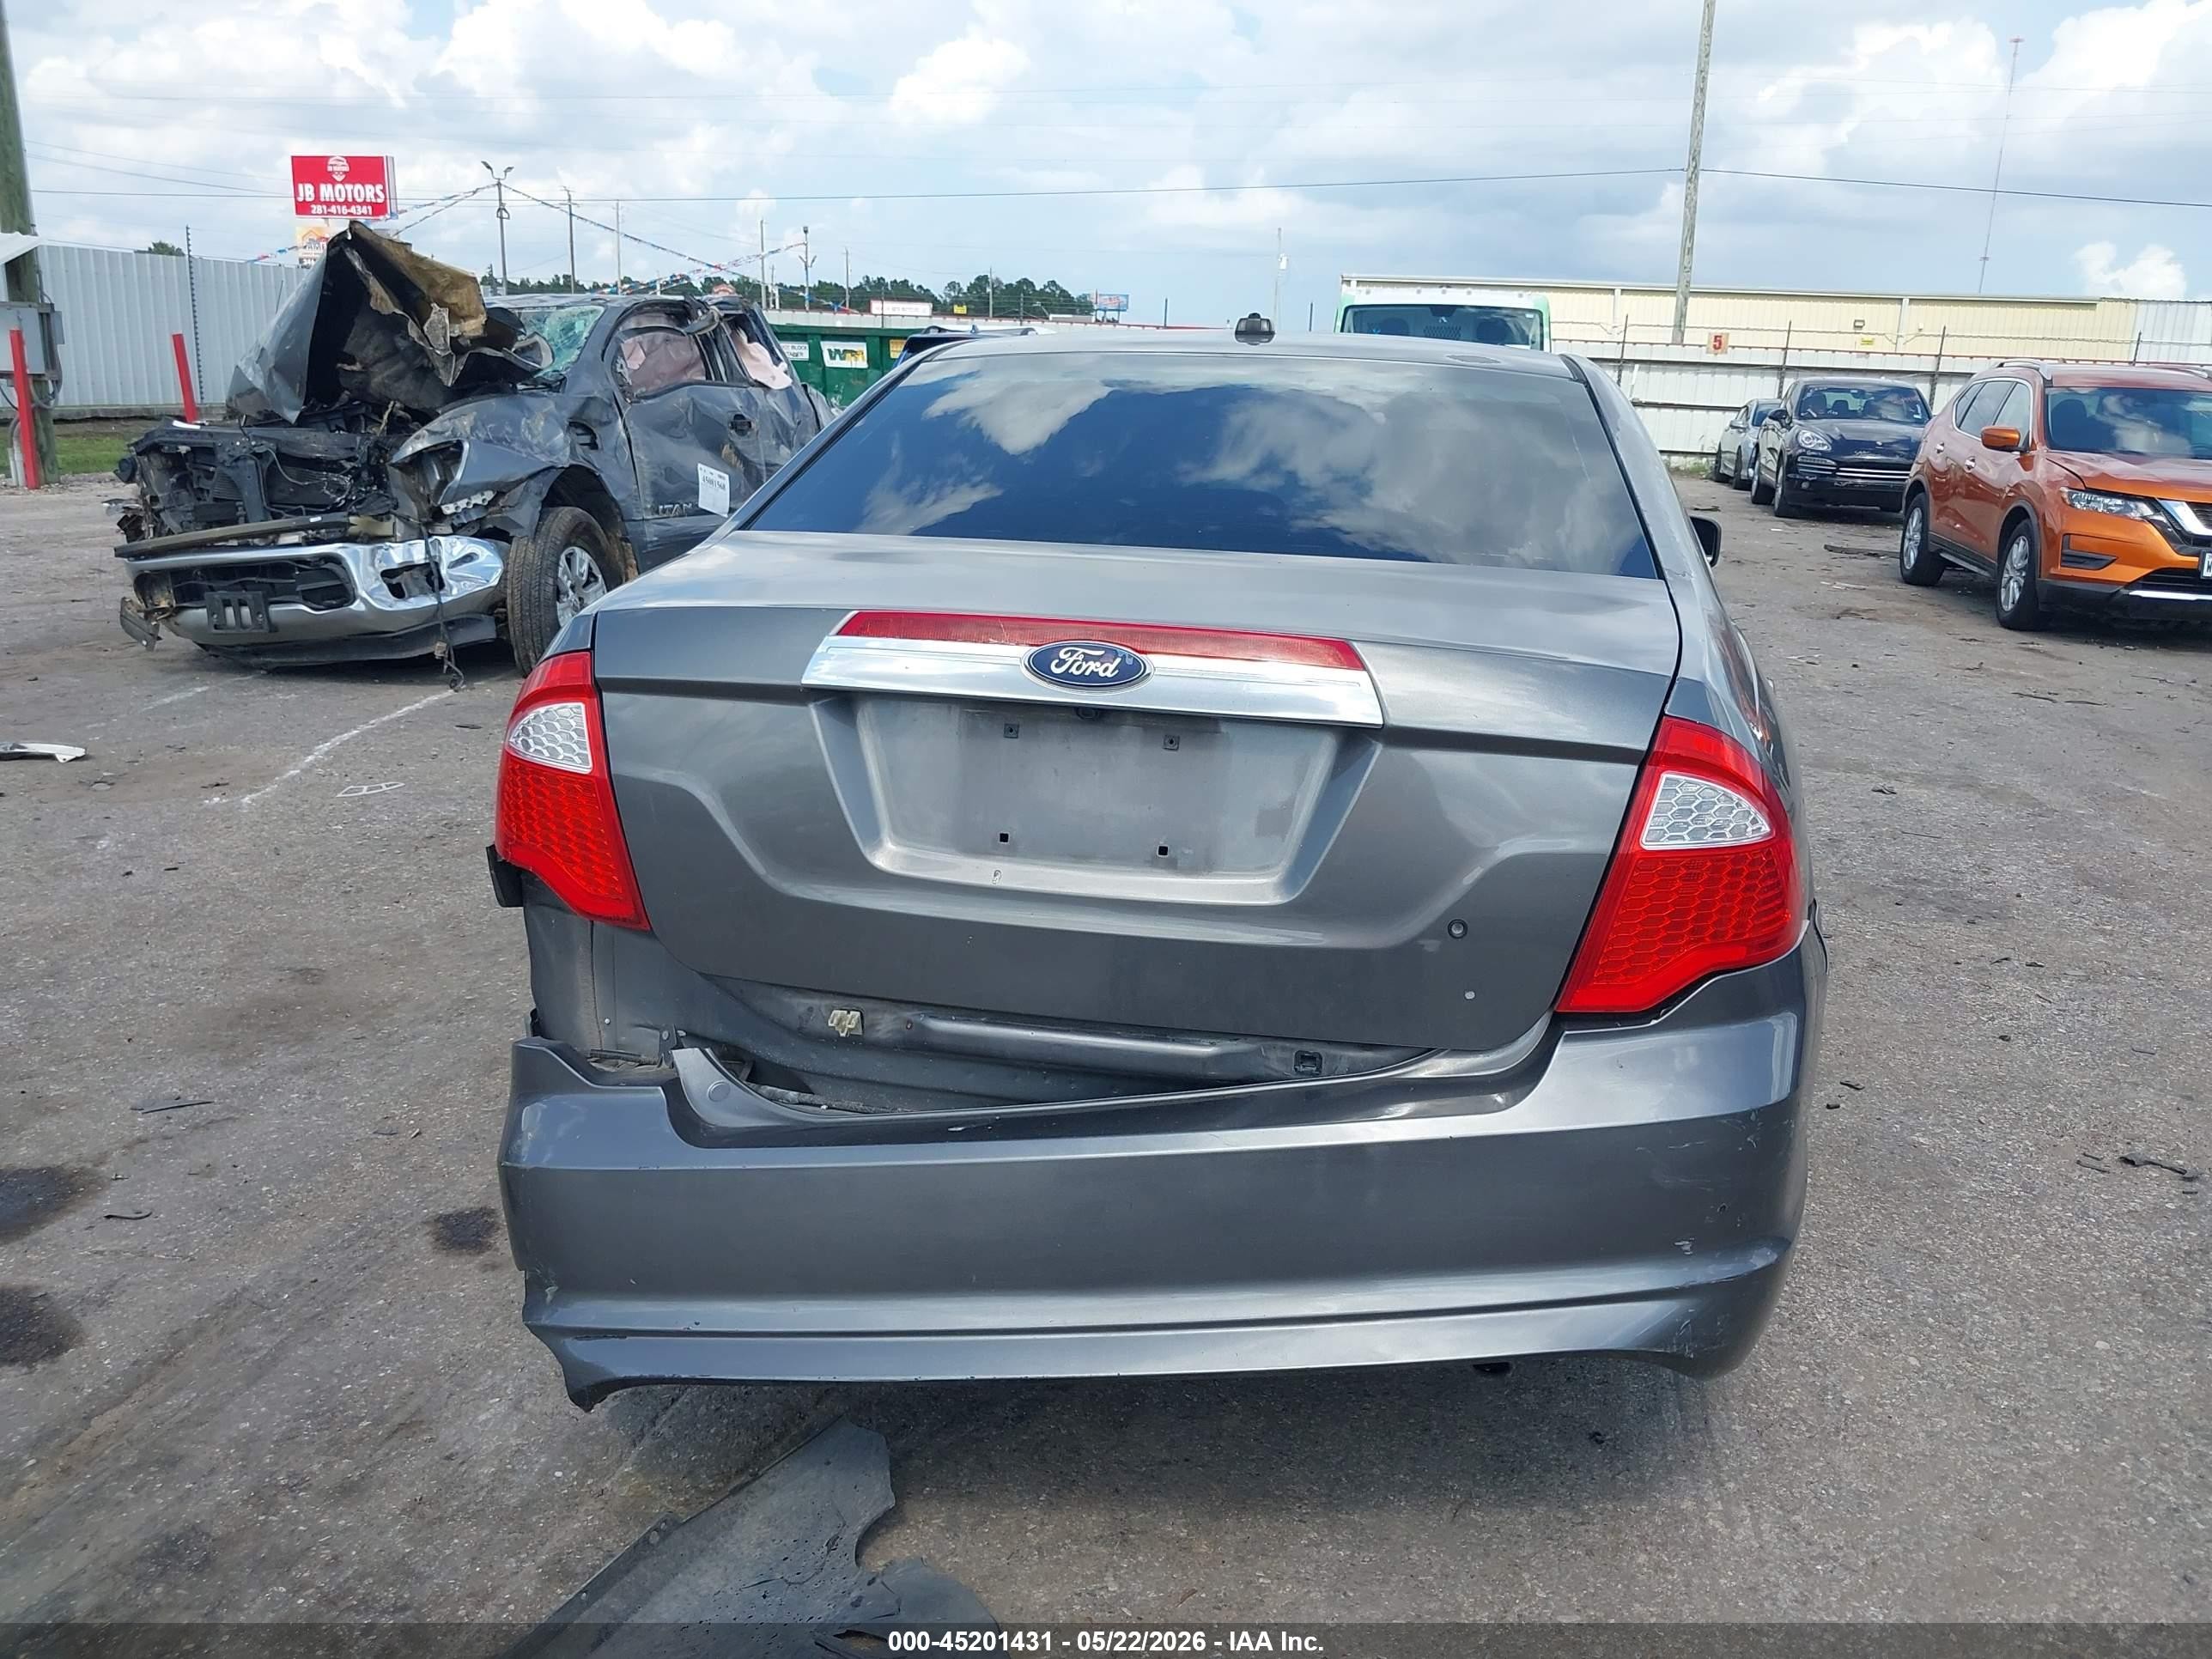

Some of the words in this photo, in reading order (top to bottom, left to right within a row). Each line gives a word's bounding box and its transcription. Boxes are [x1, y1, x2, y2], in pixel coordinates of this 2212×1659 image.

[297, 183, 315, 203] JB
[319, 183, 386, 204] MOTORS
[310, 204, 373, 216] 281-416-4341
[1712, 335, 1723, 350] 5
[1050, 647, 1121, 678] Ford
